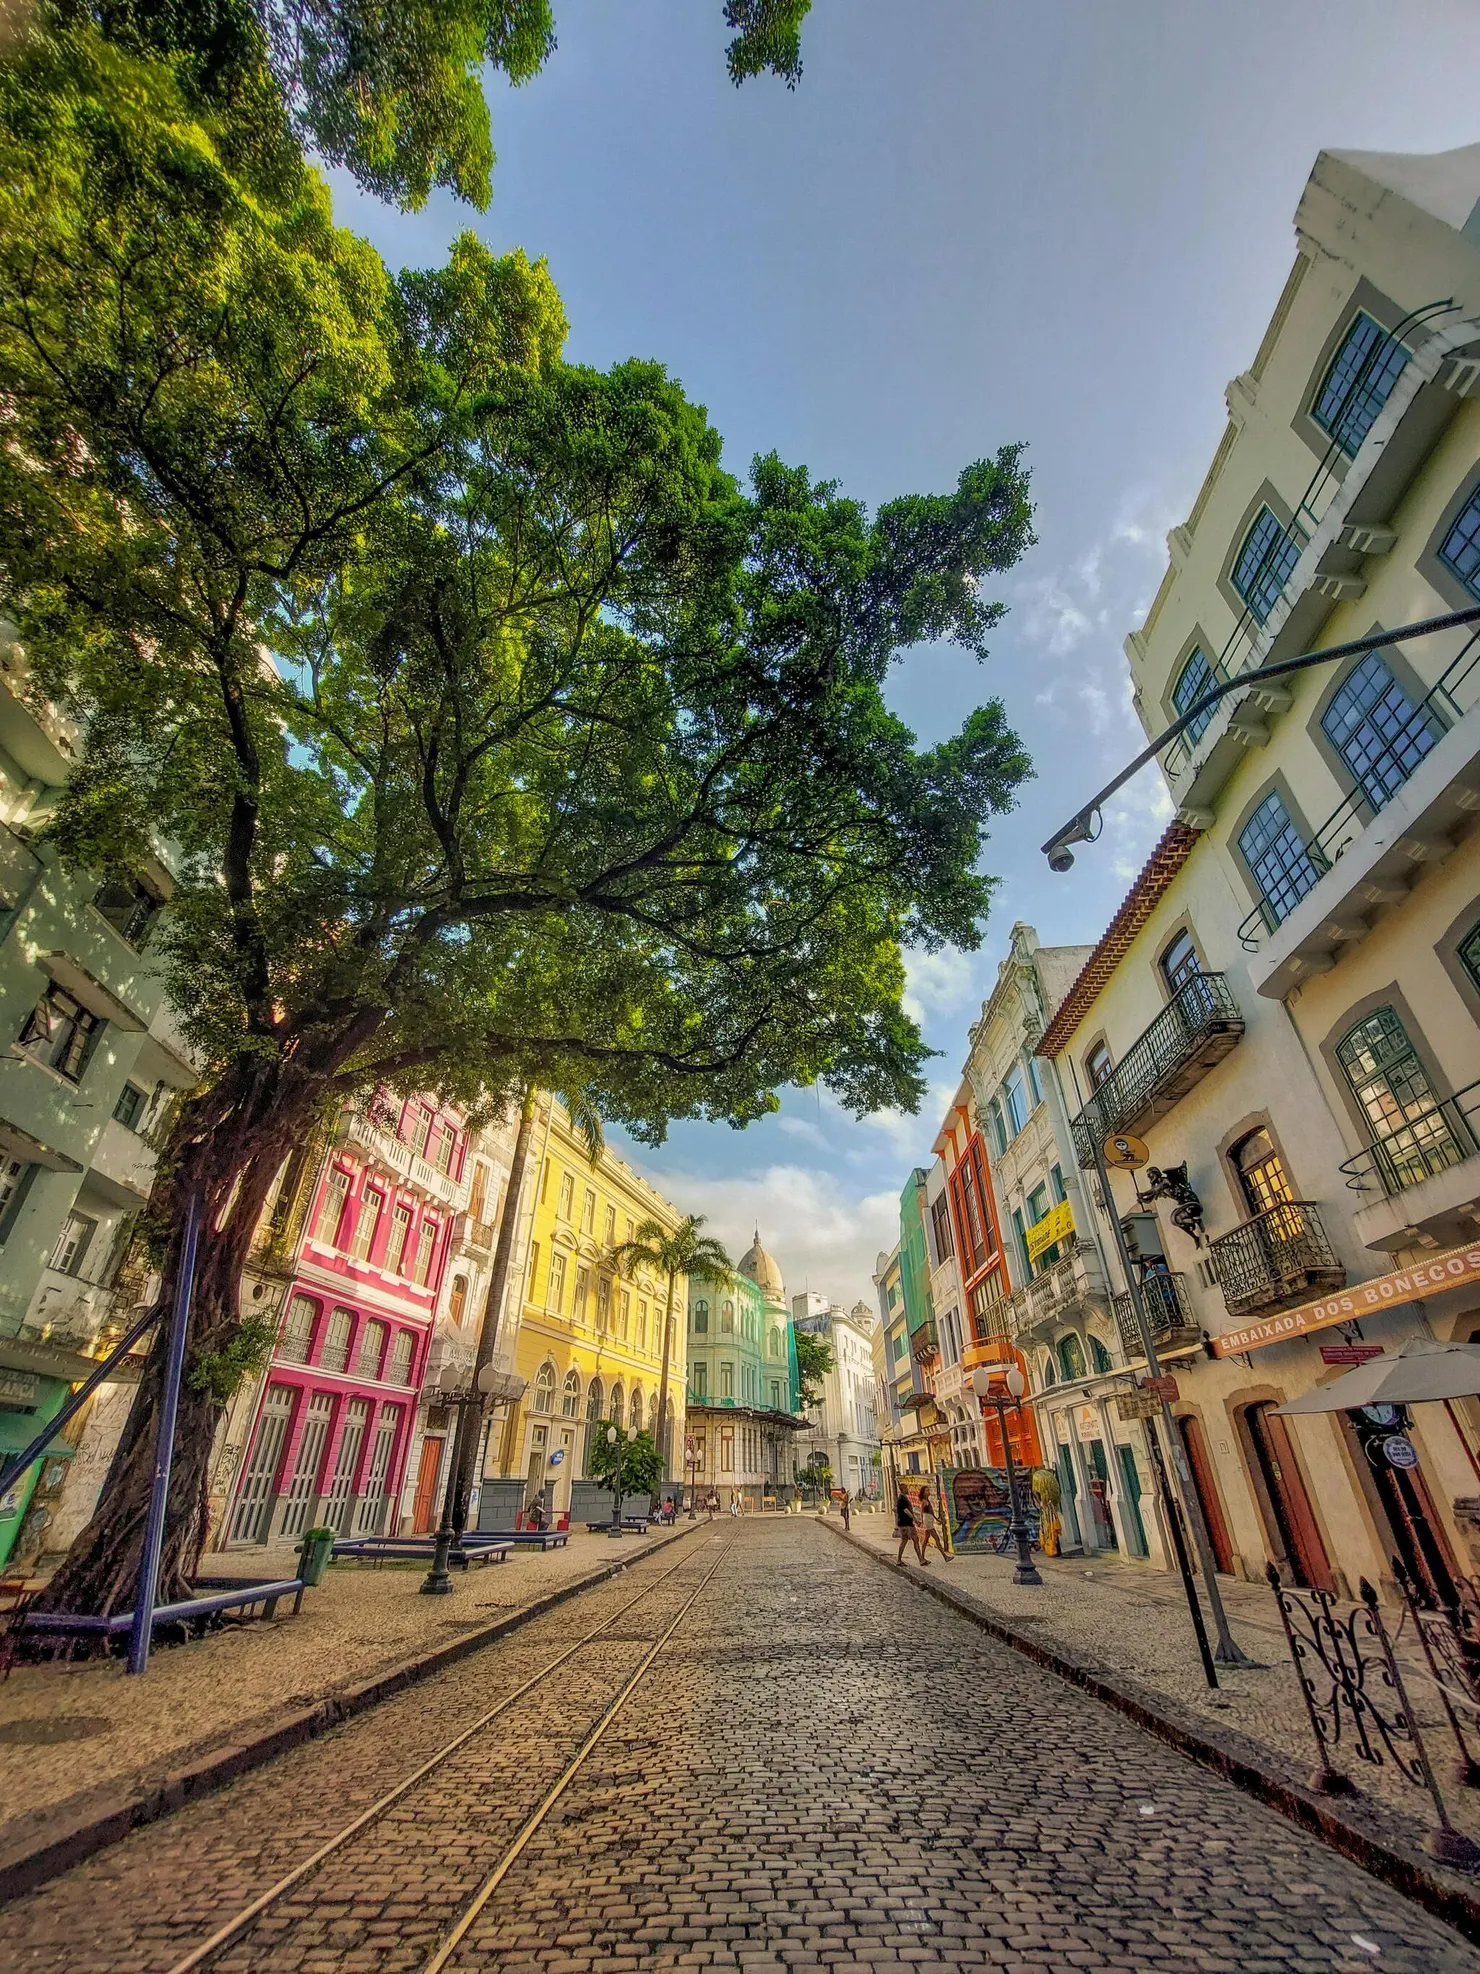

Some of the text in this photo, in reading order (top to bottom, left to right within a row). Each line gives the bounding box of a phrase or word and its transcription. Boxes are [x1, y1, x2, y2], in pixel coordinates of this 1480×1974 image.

[1221, 1313, 1307, 1350] EMBAIXADA
[1313, 1297, 1354, 1320] DOS
[1364, 1252, 1480, 1303] BONECOS
